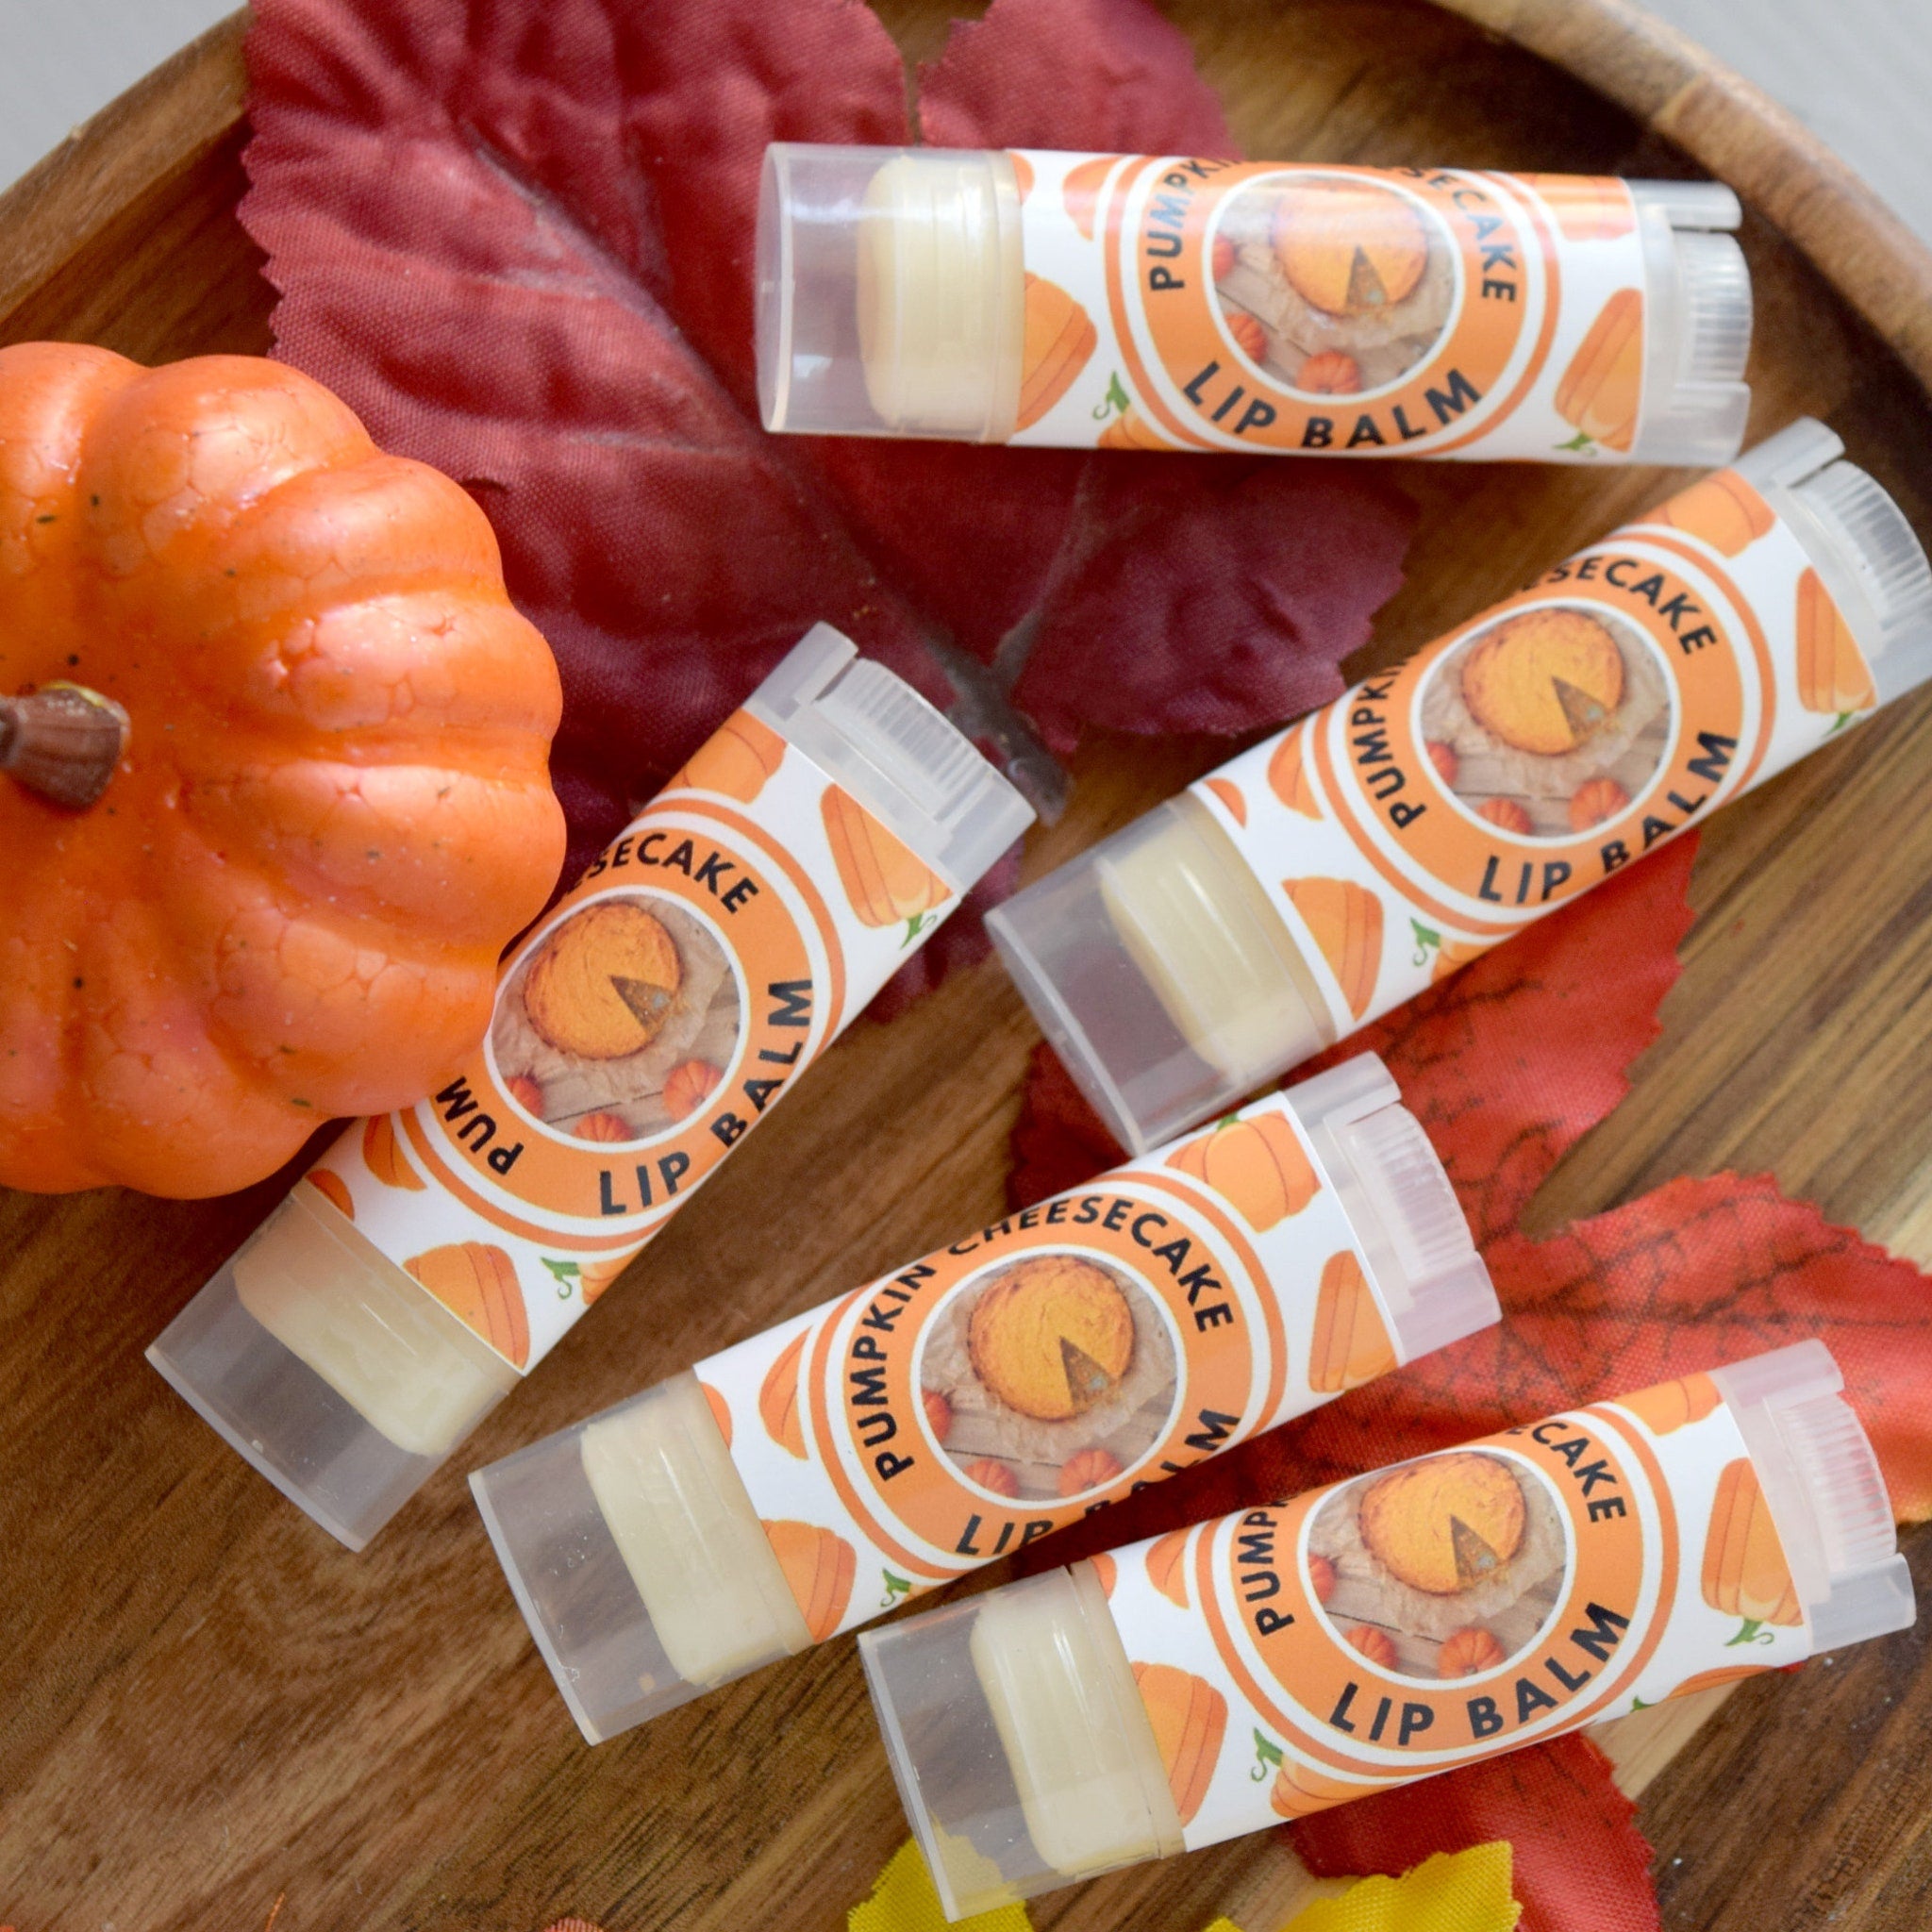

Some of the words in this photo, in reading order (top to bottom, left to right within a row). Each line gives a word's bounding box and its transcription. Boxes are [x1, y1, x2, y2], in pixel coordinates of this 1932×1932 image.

[1182, 361, 1276, 435] LIP
[1300, 369, 1485, 450] BALM
[1477, 855, 1573, 905] LIP
[1601, 731, 1739, 874] BALM
[599, 1151, 691, 1216] LIP
[709, 978, 813, 1148] BALM
[850, 1264, 937, 1481] PUMPKIN
[1328, 1682, 1435, 1745] LIP
[1466, 1602, 1631, 1739] BALM
